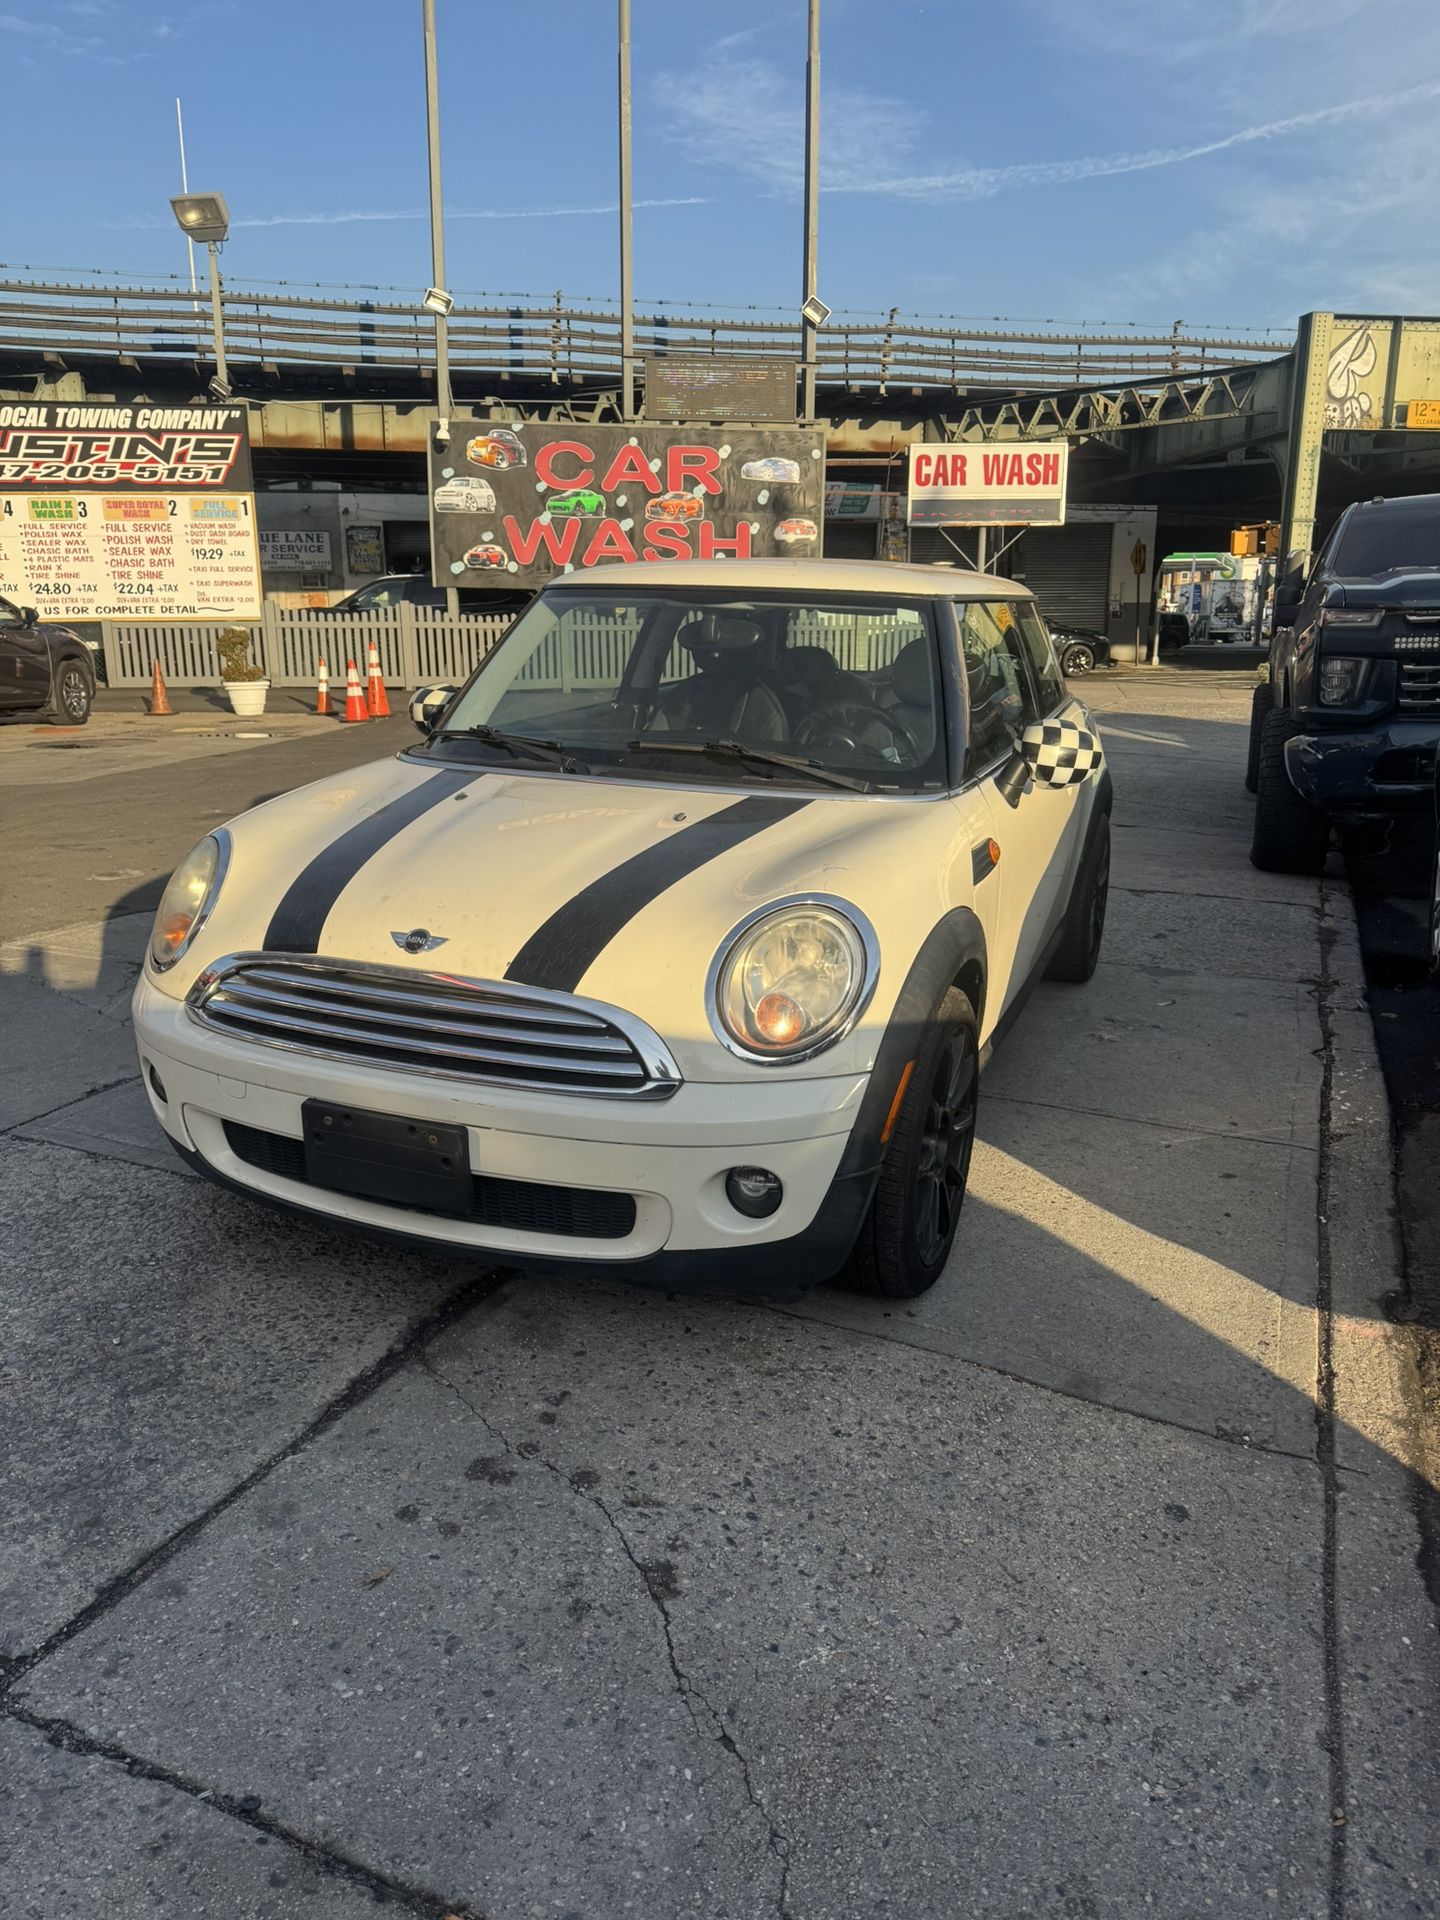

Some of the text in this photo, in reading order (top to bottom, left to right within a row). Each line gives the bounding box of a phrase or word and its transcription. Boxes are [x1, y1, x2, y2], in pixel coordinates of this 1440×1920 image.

[1415, 403, 1440, 416] 12'-
[55, 407, 133, 429] TOWING
[0, 464, 226, 480] 7-205-5151
[535, 441, 722, 494] CAR
[915, 453, 1060, 487] CAR WASH
[4, 500, 13, 517] 4
[31, 500, 73, 509] RAIN X
[78, 501, 88, 518] 3
[168, 500, 178, 516] 2
[241, 500, 249, 516] 1
[34, 510, 73, 518] WASH
[105, 523, 172, 532] FULL SERVICE
[107, 535, 174, 545] POLISH WASH
[285, 533, 325, 543] LANE
[503, 515, 752, 567] WASH
[27, 547, 61, 555] CHASIC
[109, 547, 172, 556] SEALER WAX
[191, 548, 223, 560] $19.29
[271, 544, 325, 553] SERVICE
[110, 558, 175, 568] CHASIC BATH
[111, 570, 164, 580] TIRE SHINE
[29, 582, 71, 595] $24.80
[113, 582, 154, 595] $22.04
[44, 606, 60, 615] US
[66, 606, 89, 614] FOR
[95, 606, 155, 614] COMPLETE
[161, 605, 198, 614] DETAIL
